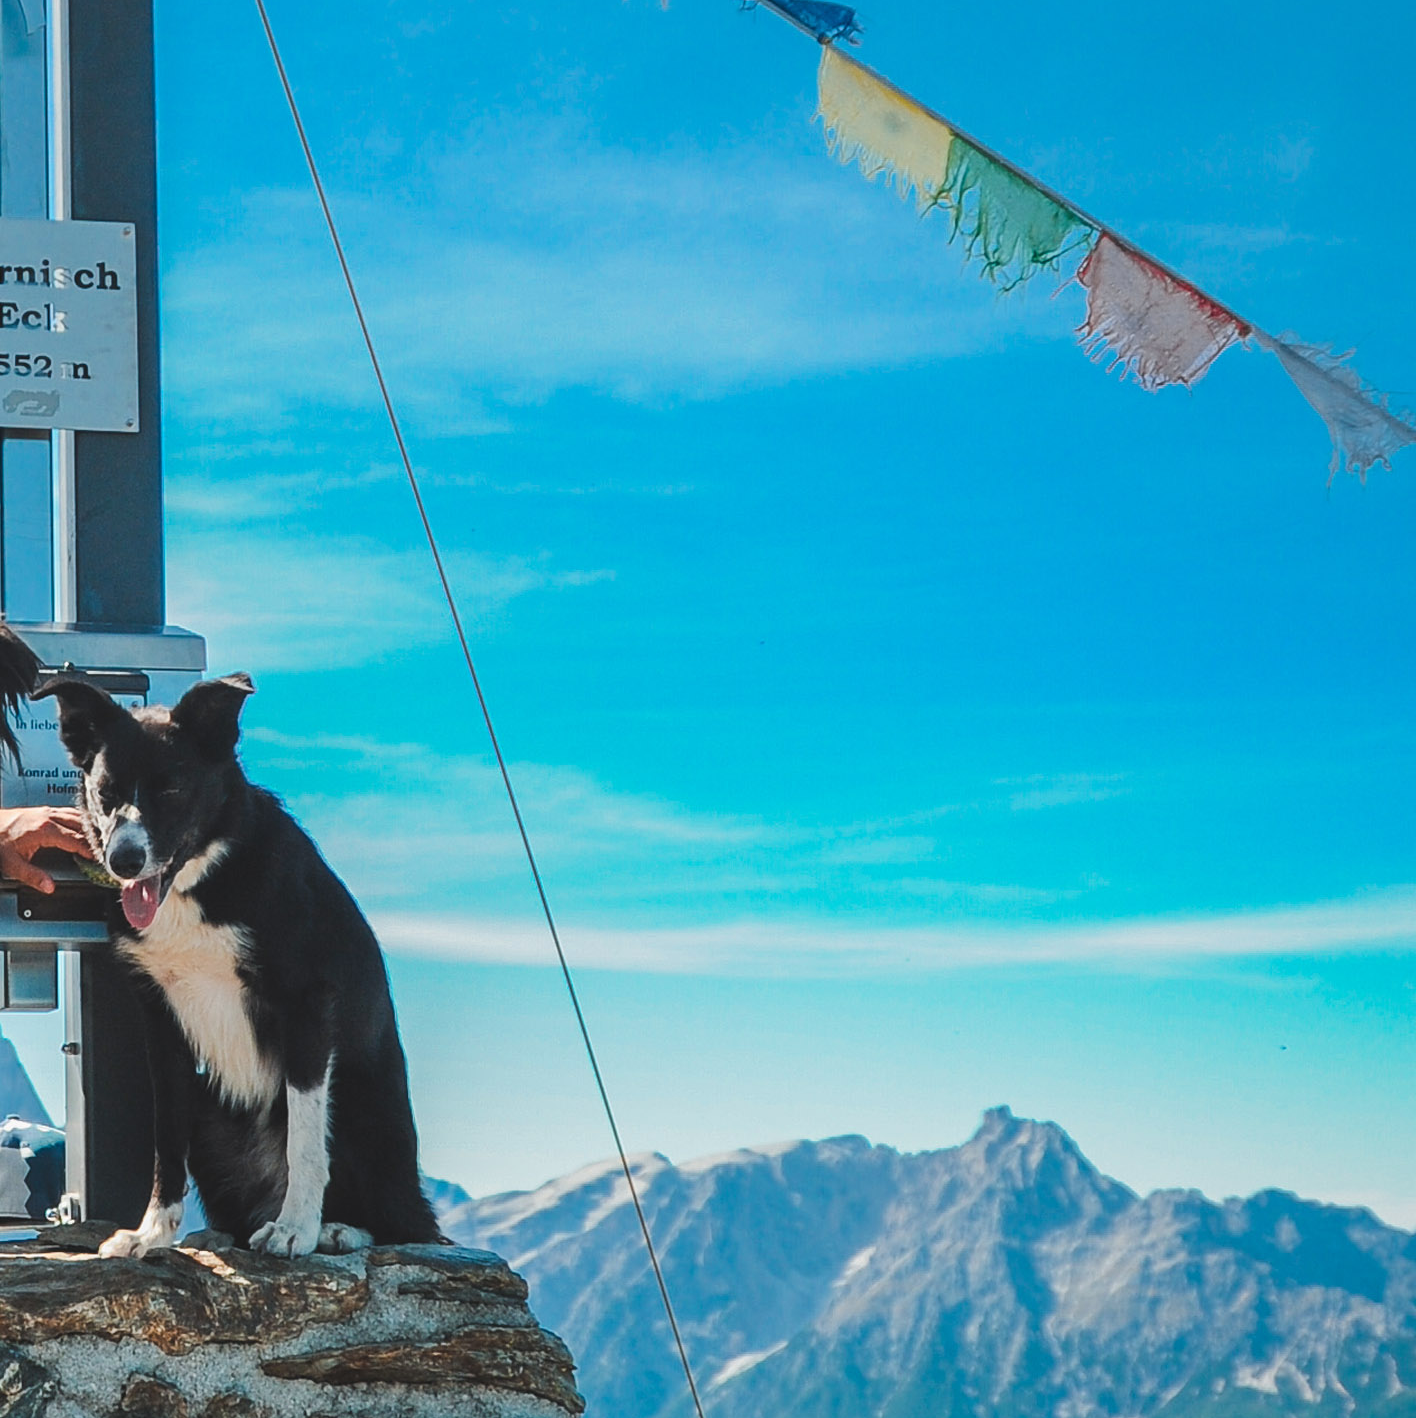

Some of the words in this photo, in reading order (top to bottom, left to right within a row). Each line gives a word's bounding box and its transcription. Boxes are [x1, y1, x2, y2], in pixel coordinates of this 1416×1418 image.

[30, 719, 59, 730] liebe
[18, 767, 59, 778] Konrad
[47, 783, 79, 794] Hofm
